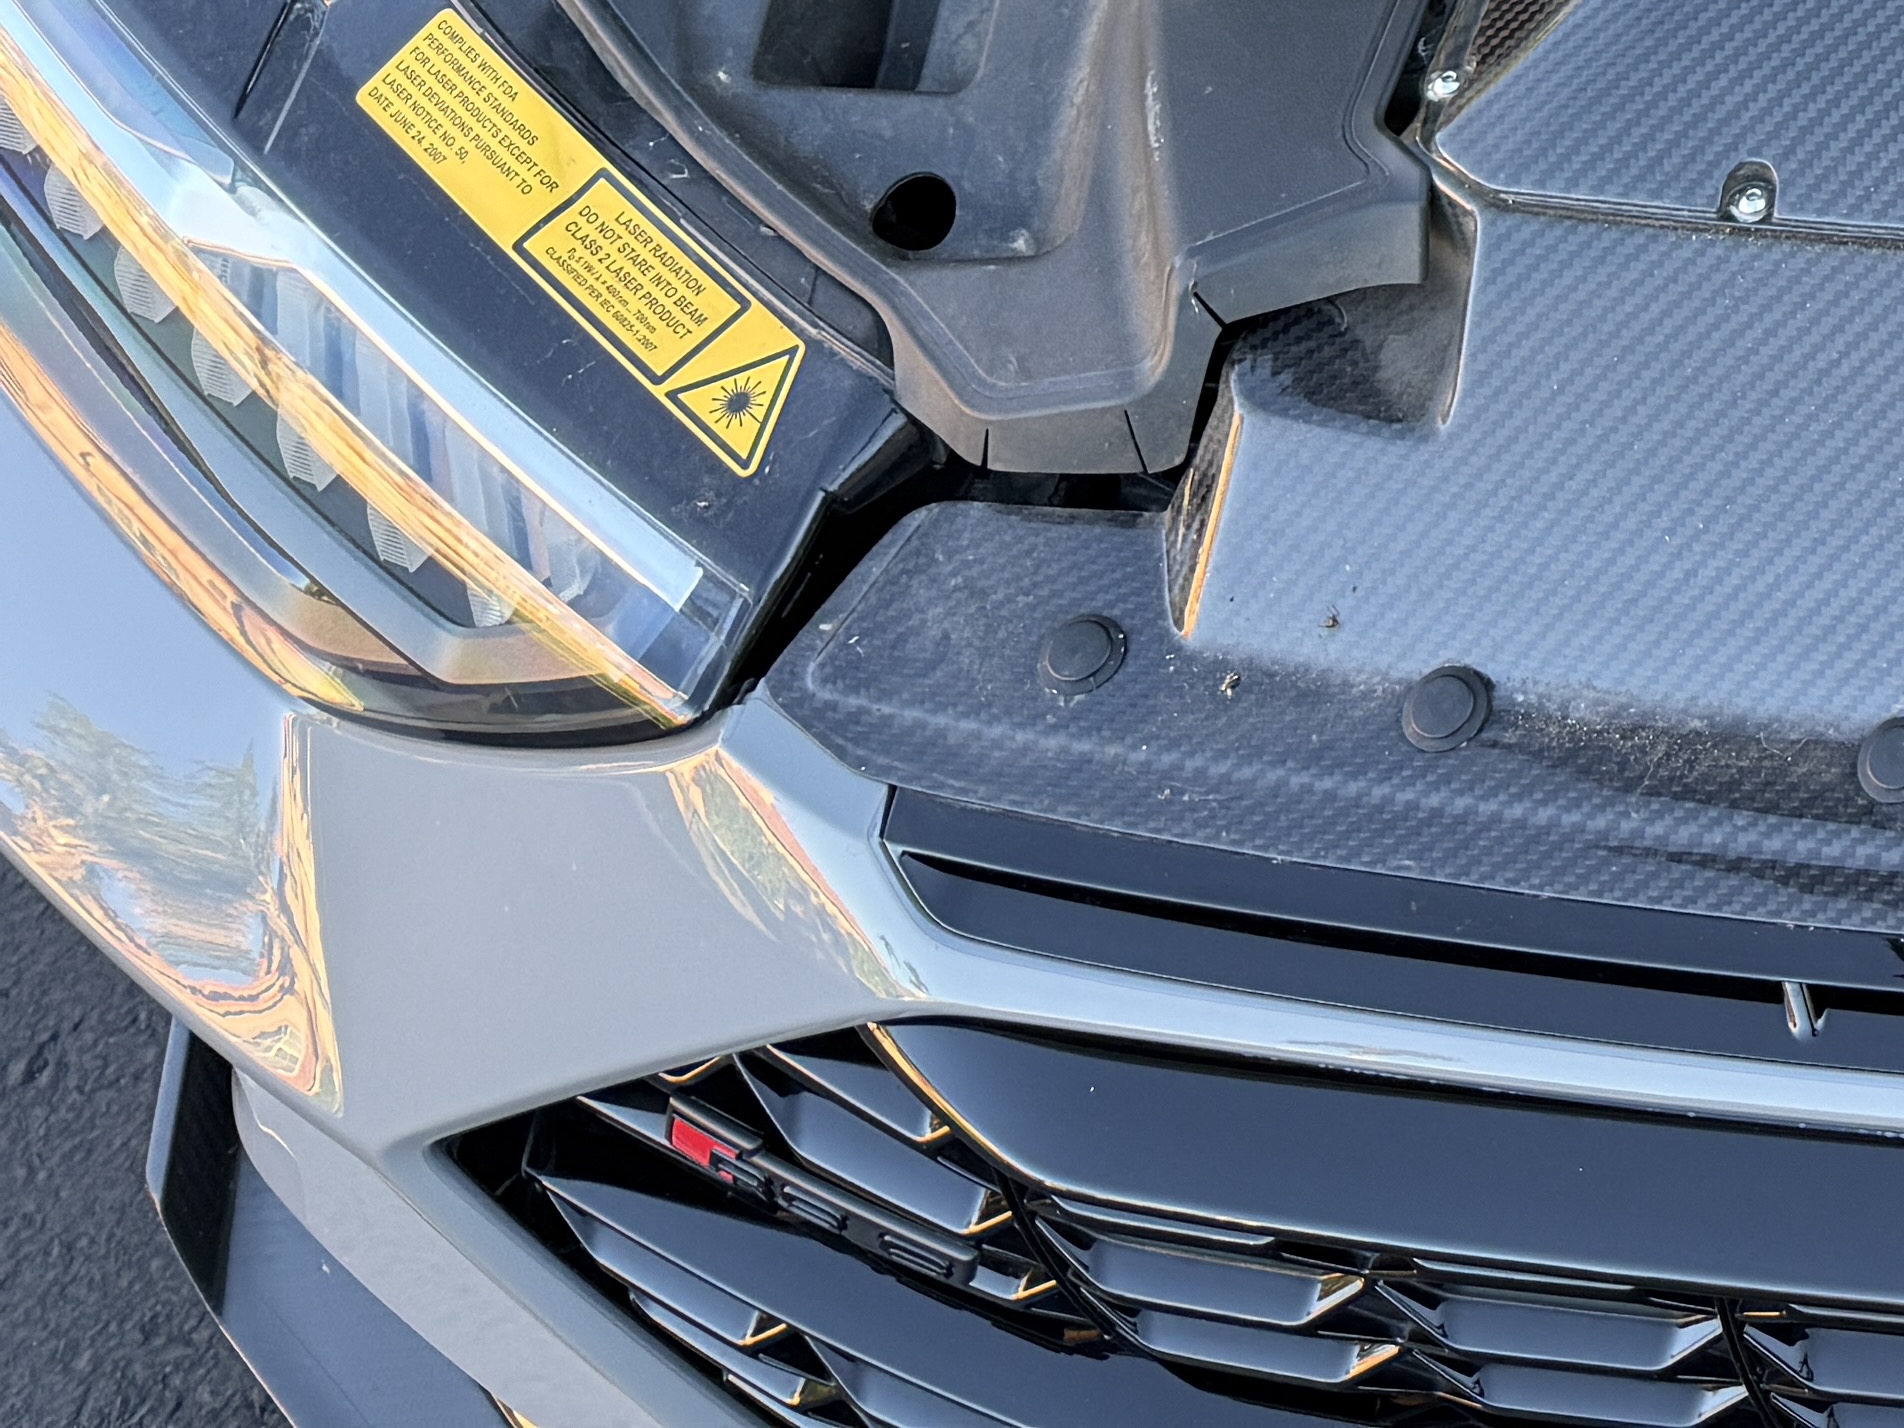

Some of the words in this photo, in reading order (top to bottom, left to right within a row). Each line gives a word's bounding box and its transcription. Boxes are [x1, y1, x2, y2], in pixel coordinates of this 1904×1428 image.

[421, 32, 487, 96] PERFORMANCE
[481, 91, 538, 147] STANDARDS
[435, 19, 481, 63] COMPLIES
[476, 59, 502, 84] WITH
[497, 79, 520, 102] FDA
[367, 86, 393, 112] DATE
[388, 107, 416, 135] JUNE
[422, 141, 447, 166] 2007
[380, 72, 413, 104] LASER
[408, 100, 443, 134] NOTICE
[438, 129, 459, 150] NO.
[452, 145, 472, 164] 50,
[394, 59, 427, 91] LASER
[421, 86, 474, 138] DEVIATIONS
[468, 132, 520, 183] PURSUANT
[514, 178, 534, 197] TO
[408, 45, 431, 68] FOR
[425, 63, 458, 95] LASER
[452, 90, 502, 139] PRODUCTS
[498, 134, 538, 173] EXCEPT
[532, 167, 560, 194] FOR
[543, 246, 588, 288] CLASSIFIED
[583, 284, 603, 301] PER
[598, 298, 615, 313] IEC
[563, 219, 604, 257] CLASS
[597, 251, 611, 264] 2
[604, 258, 645, 296] LASER
[637, 290, 693, 341] PRODUCT
[577, 205, 600, 225] DO
[593, 220, 622, 247] NOT
[616, 241, 655, 277] STARE
[648, 271, 679, 299] INTO
[672, 294, 708, 327] BEAM
[613, 211, 654, 248] LASER
[648, 242, 707, 297] RADIATION
